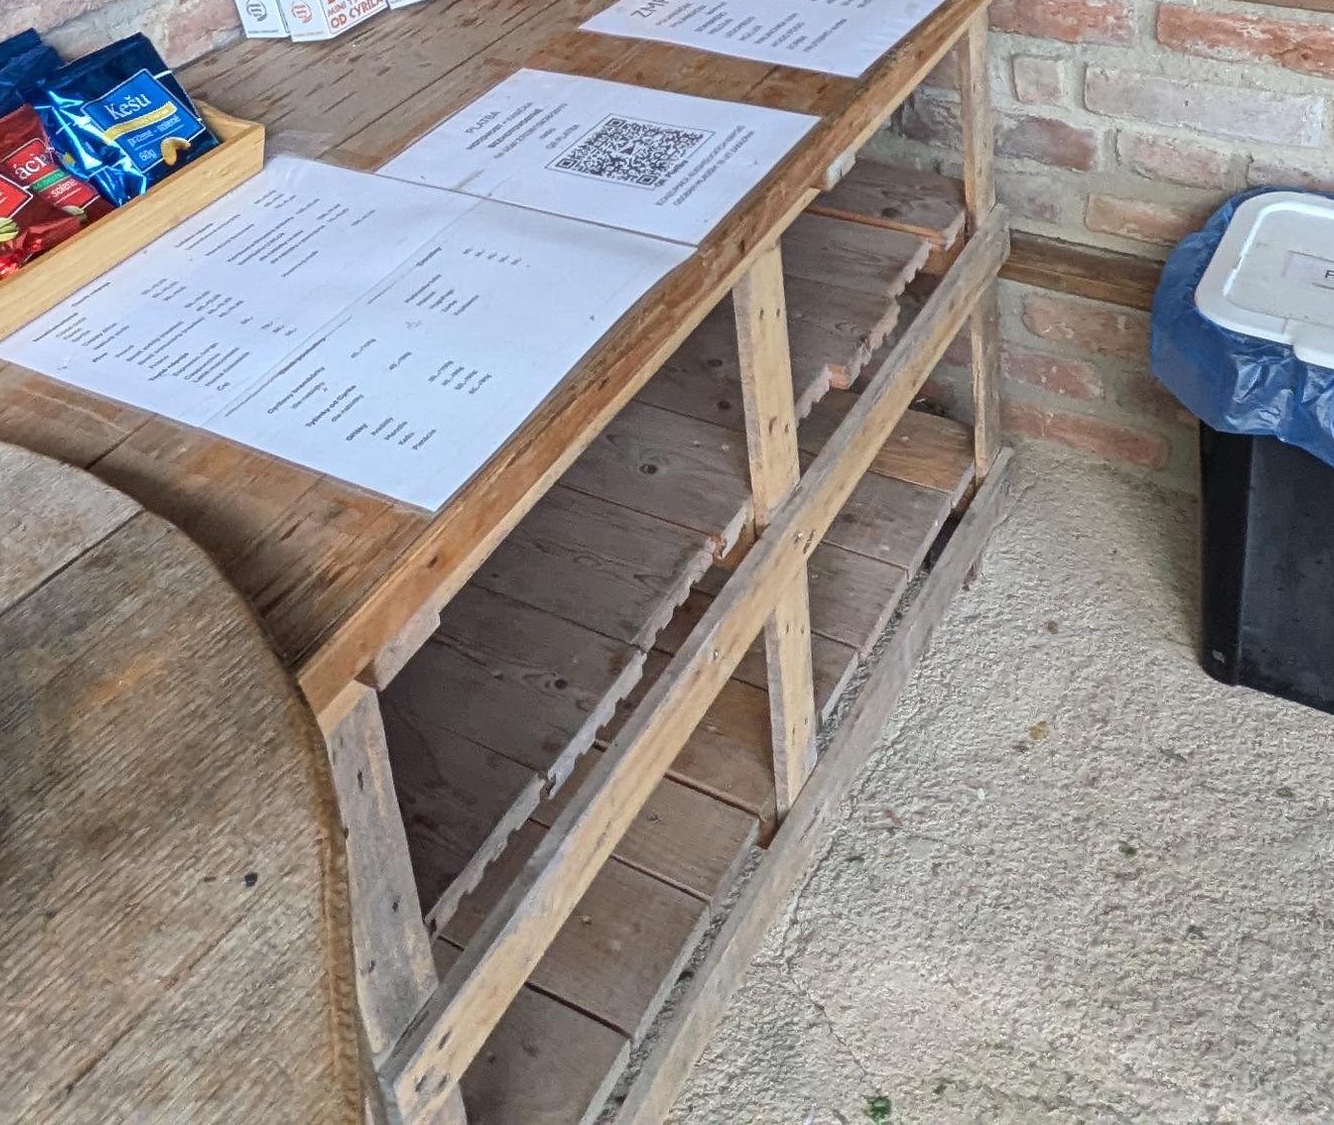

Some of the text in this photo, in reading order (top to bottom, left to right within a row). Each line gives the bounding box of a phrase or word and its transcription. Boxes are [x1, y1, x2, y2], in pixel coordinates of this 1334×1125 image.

[330, 13, 347, 29] OD
[104, 93, 152, 120] Kešu
[465, 112, 501, 133] PLATBA
